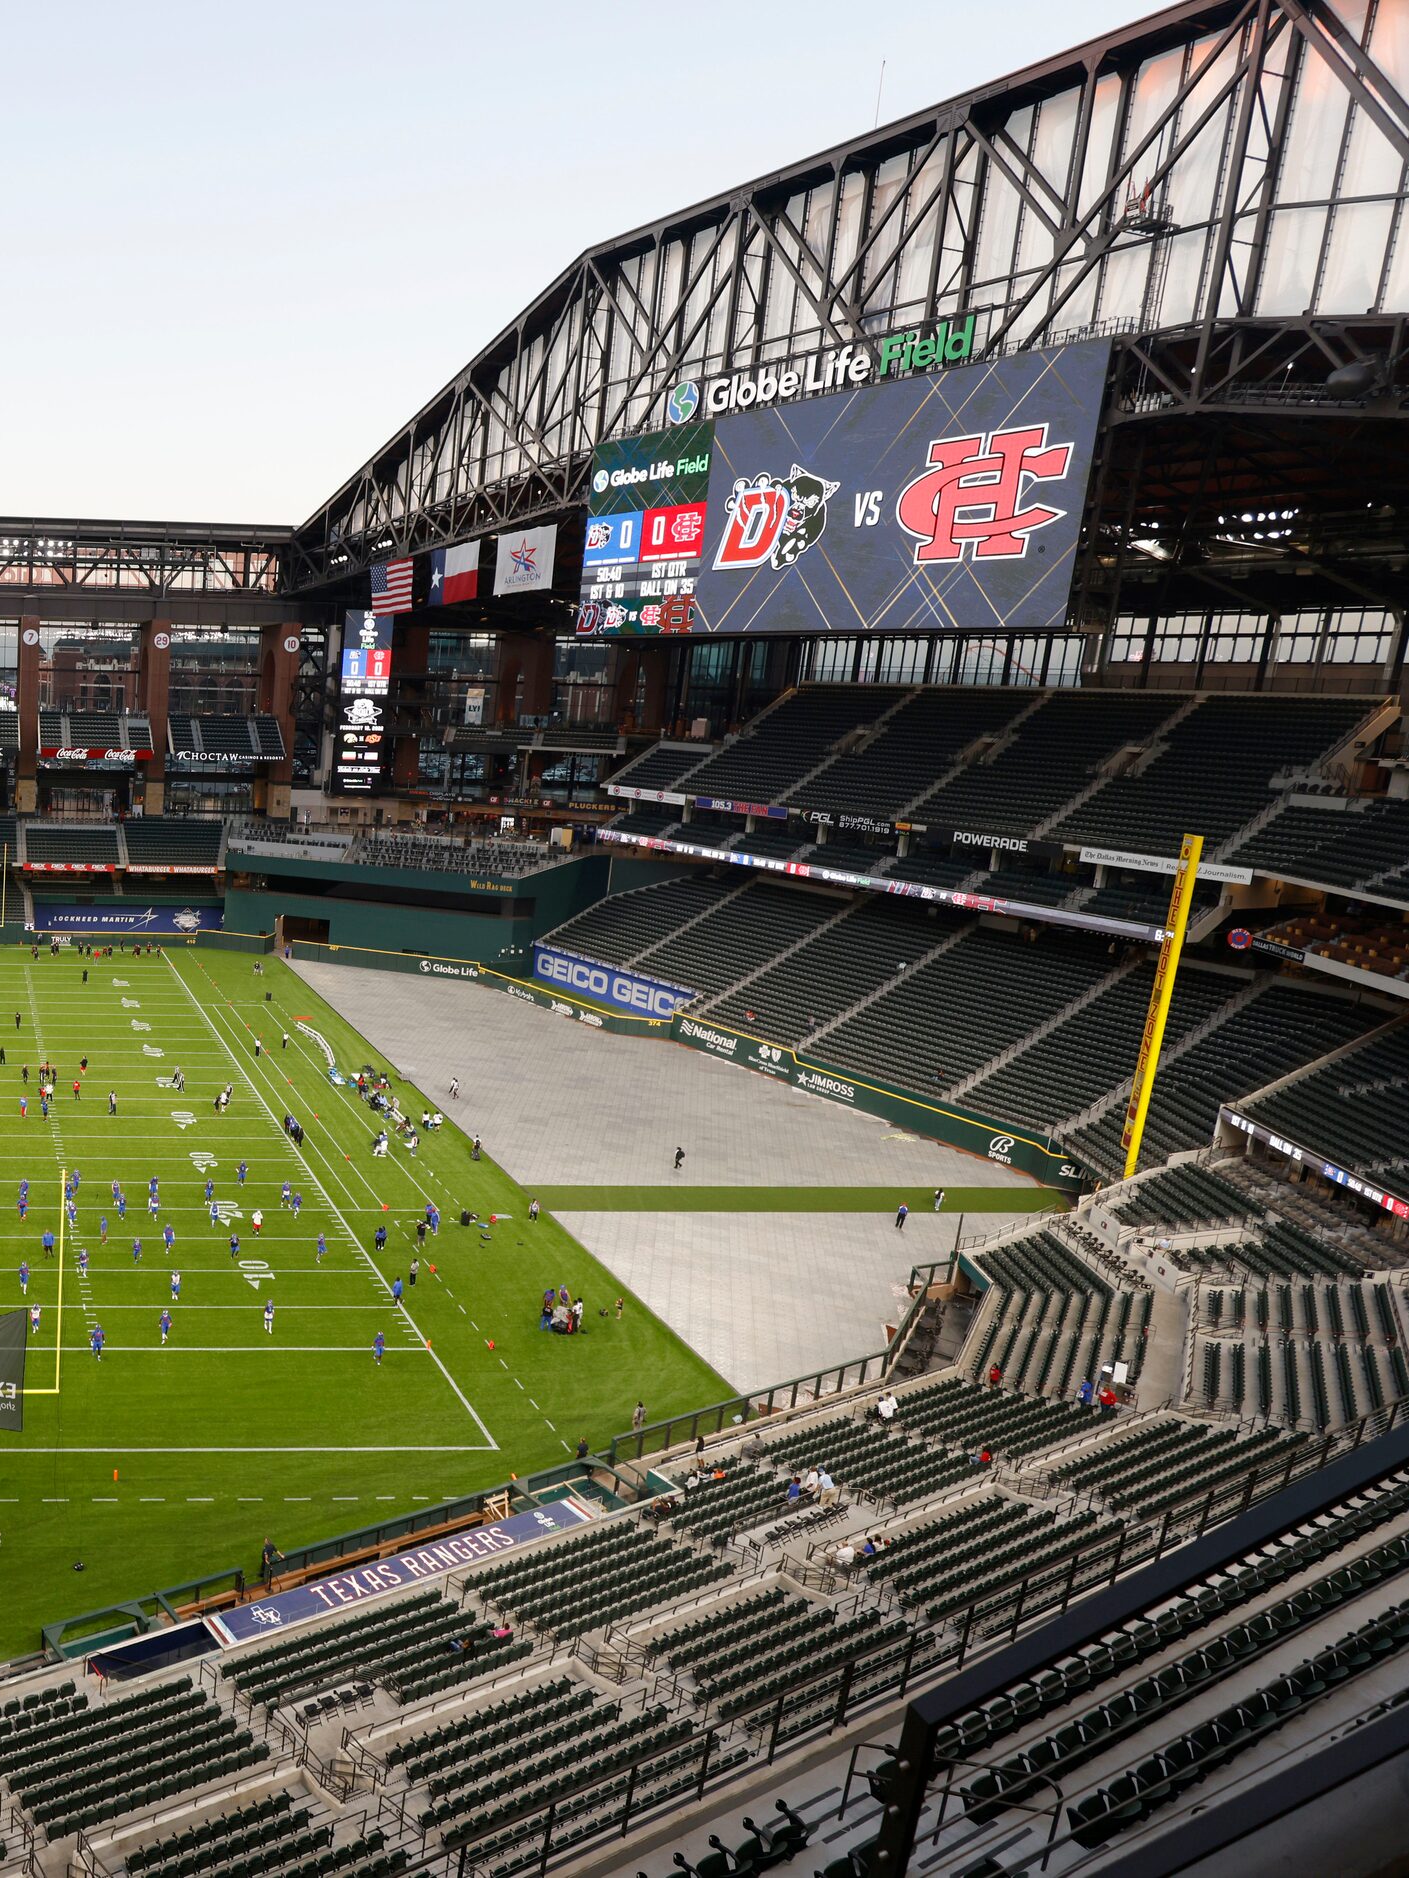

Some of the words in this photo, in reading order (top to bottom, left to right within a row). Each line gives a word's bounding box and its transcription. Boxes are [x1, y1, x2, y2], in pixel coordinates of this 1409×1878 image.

[707, 368, 804, 413] Globe
[806, 345, 871, 392] Life
[878, 316, 976, 376] Field
[610, 470, 648, 487] Globe
[649, 462, 674, 480] Life
[676, 454, 709, 476] Field
[854, 491, 883, 527] VS
[620, 521, 633, 549] 0
[652, 516, 666, 545] 0
[597, 566, 622, 582] 50:40
[652, 562, 666, 578] 1ST
[667, 561, 687, 577] QTR
[504, 572, 542, 585] ARLINGTON
[591, 584, 604, 599] 1ST
[615, 583, 624, 598] 10
[640, 581, 662, 597] BALL
[664, 580, 678, 595] ON
[680, 579, 694, 594] 35
[28, 632, 34, 642] 7
[156, 636, 168, 646] 29
[287, 640, 296, 649] 10
[351, 661, 359, 675] 0
[374, 661, 383, 675] 0
[183, 750, 239, 761] CHOCTAW
[569, 802, 616, 811] PLUCKERS
[711, 800, 732, 810] 105.3
[810, 812, 834, 824] PGL
[840, 815, 891, 827] ShipPGL.com
[839, 822, 890, 834] 877.701.1919
[953, 831, 1029, 851] POWERADE
[1096, 853, 1115, 862] Dallas
[1116, 855, 1142, 868] Morning
[1142, 859, 1159, 868] News
[470, 880, 485, 889] WILD
[486, 881, 498, 891] RAG
[1169, 870, 1185, 927] THE
[25, 923, 34, 931] 25
[51, 936, 72, 944] TRULY
[1253, 940, 1269, 950] DALLAS
[1269, 944, 1286, 956] TRUCK
[433, 964, 459, 975] Globe
[461, 967, 478, 977] Life
[1158, 940, 1171, 989] HOT
[537, 953, 608, 994] GEICO
[692, 1025, 737, 1050] National
[1140, 1004, 1158, 1071] ZONE
[706, 1041, 715, 1050] Car
[716, 1045, 733, 1056] Rental
[808, 1073, 854, 1097] JIMROSS
[988, 1150, 1011, 1164] SPORTS
[310, 1564, 402, 1608] TEXAS
[400, 1527, 514, 1575] RANGERS
